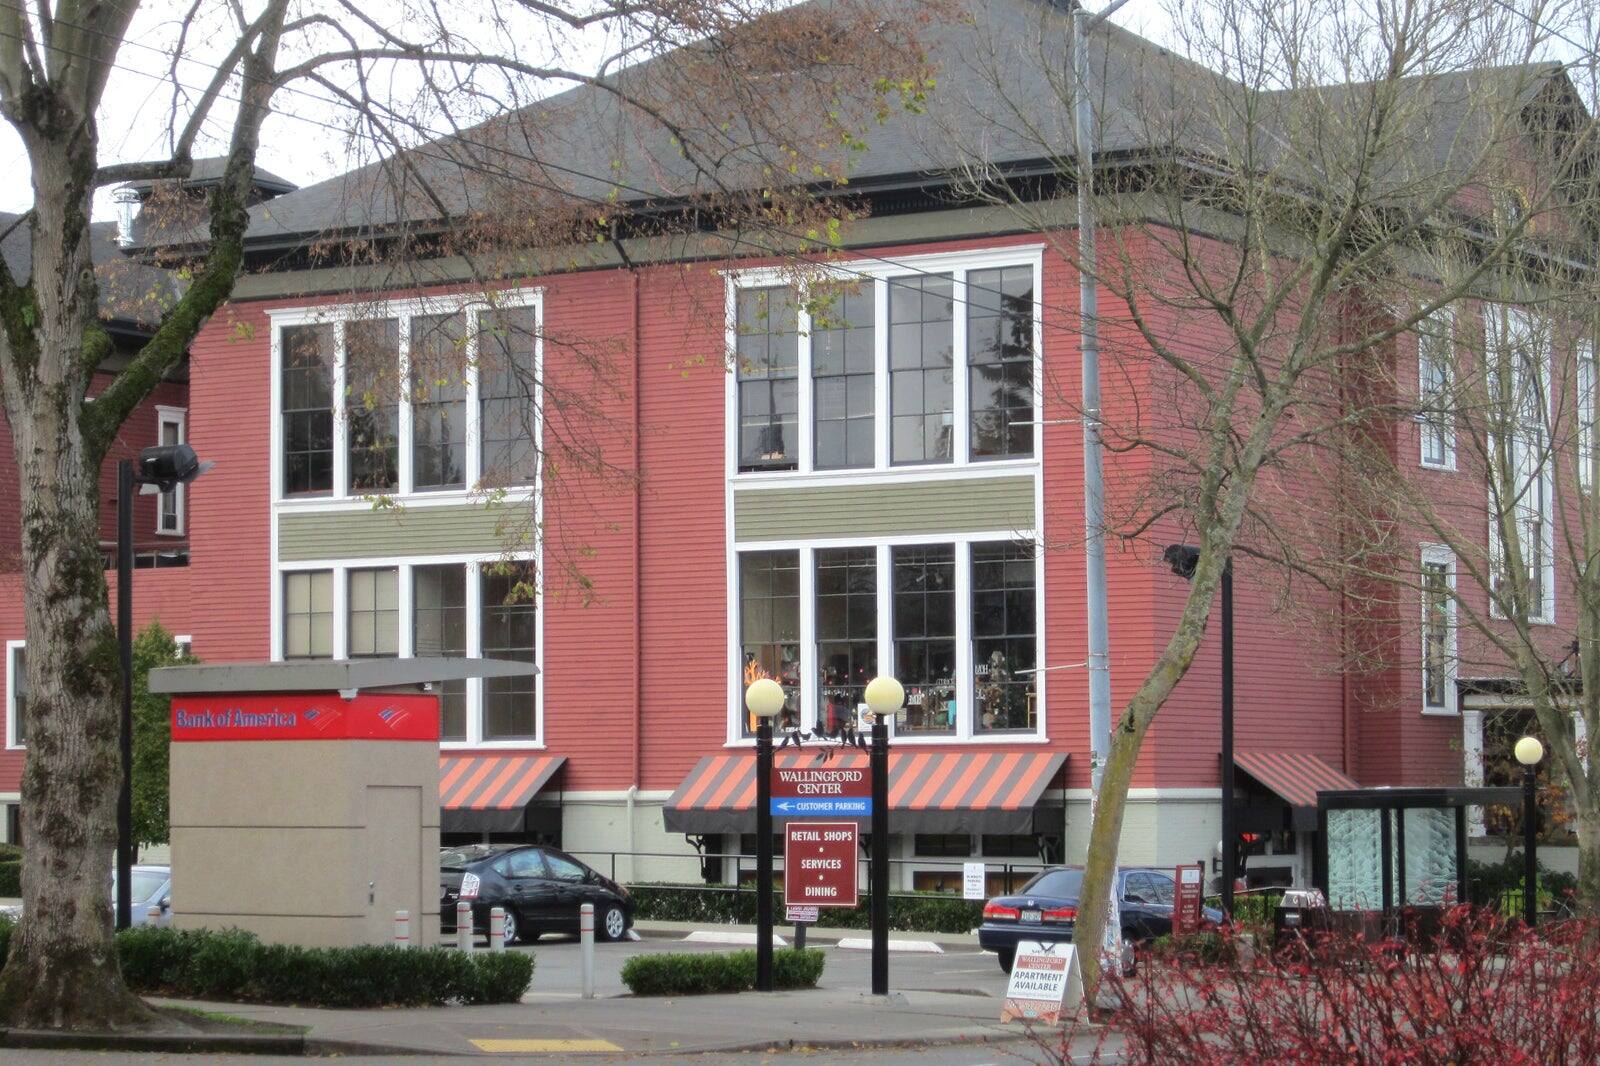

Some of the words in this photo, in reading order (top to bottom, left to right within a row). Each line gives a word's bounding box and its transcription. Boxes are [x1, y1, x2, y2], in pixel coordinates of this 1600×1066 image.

[176, 709, 215, 728] Bank
[217, 708, 232, 727] of
[234, 708, 297, 727] America
[779, 771, 863, 782] WALLINGFORD
[797, 783, 842, 794] CENTER
[796, 802, 833, 811] CUSTOMER
[835, 802, 866, 811] PARKING
[791, 831, 821, 841] RETAIL
[824, 831, 853, 841] SHOPS
[801, 859, 842, 869] SERVICES
[805, 886, 838, 897] DINING
[1013, 971, 1064, 981] APARTMENT
[1014, 981, 1059, 992] AVAILABLE
